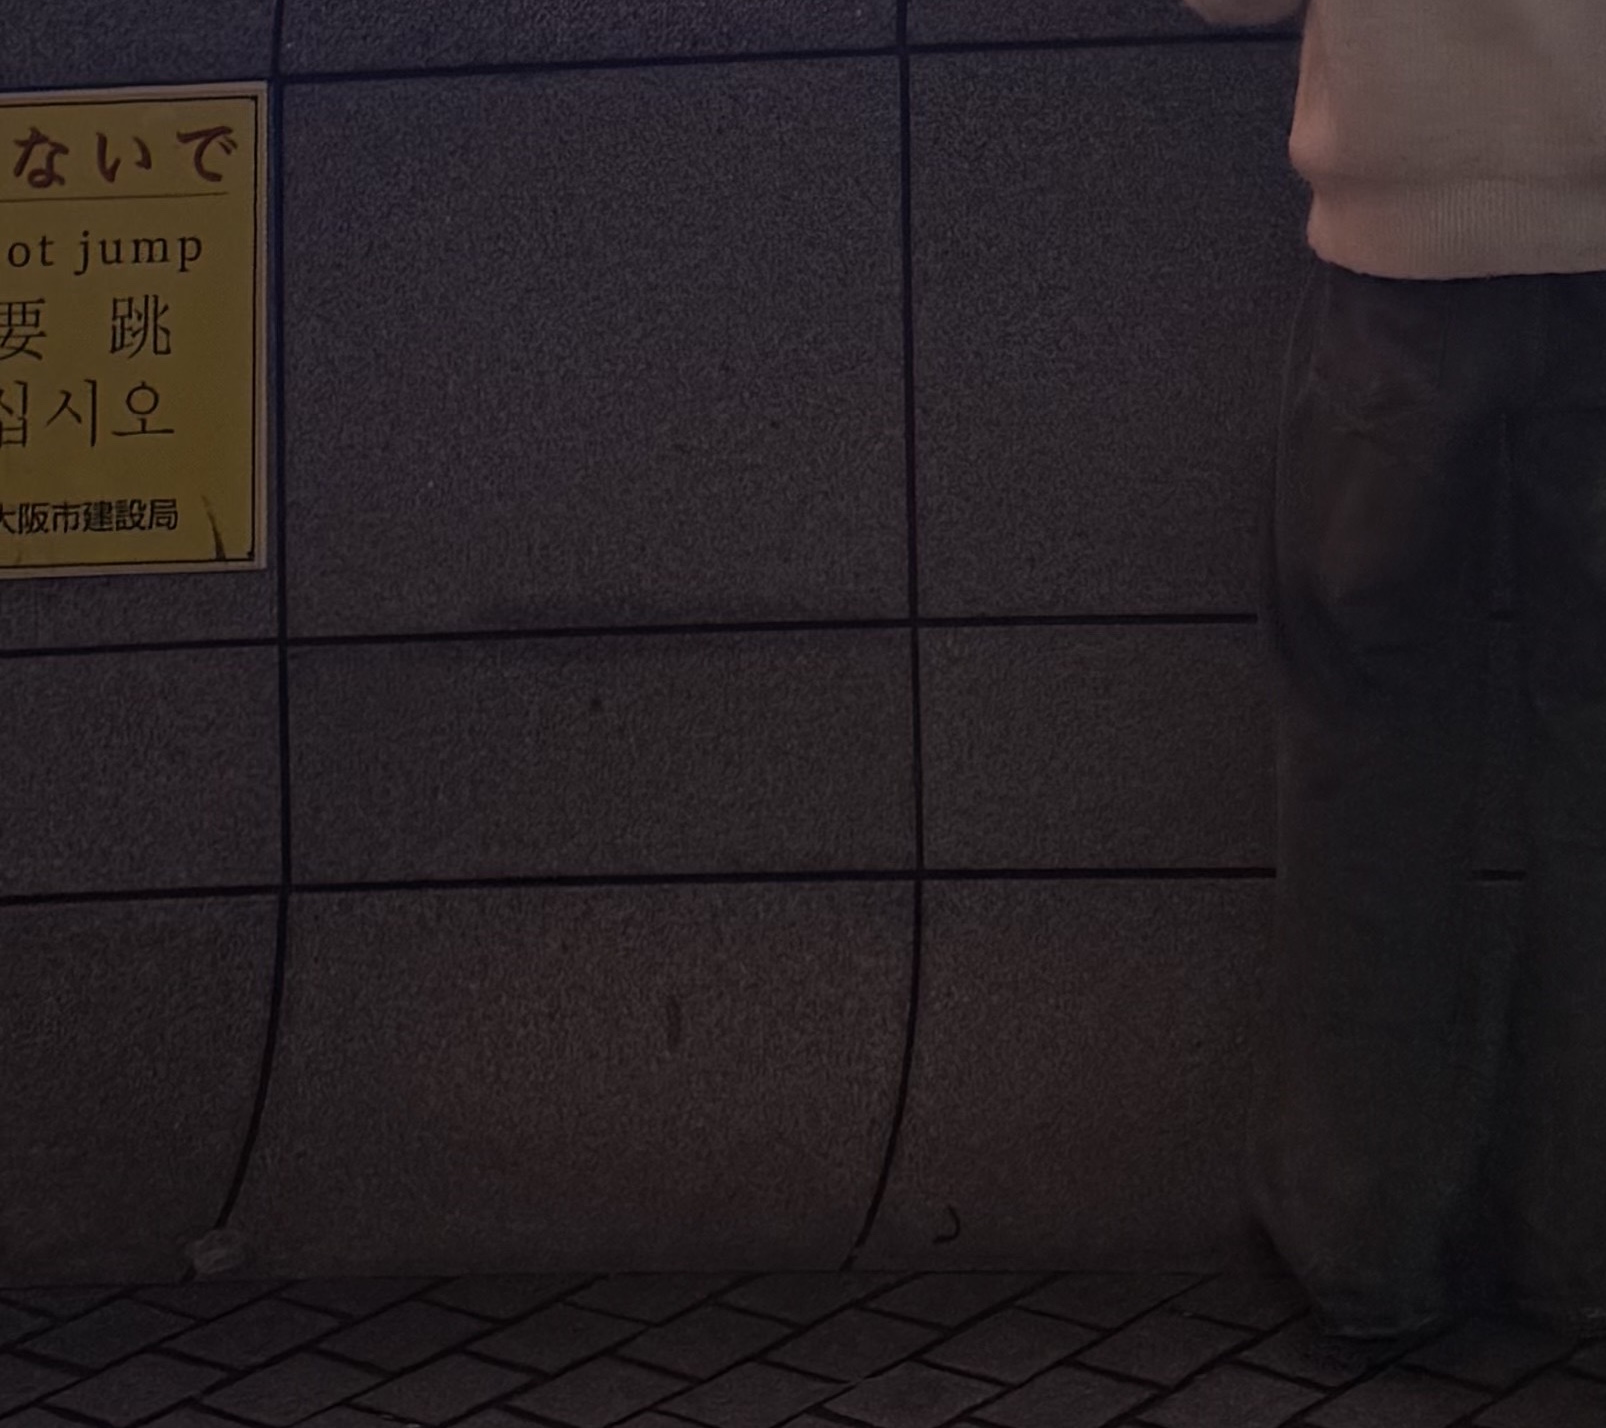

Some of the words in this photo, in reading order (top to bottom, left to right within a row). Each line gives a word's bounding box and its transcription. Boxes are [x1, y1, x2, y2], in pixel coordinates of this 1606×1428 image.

[13, 125, 238, 189] ないで
[8, 235, 54, 269] ot
[74, 230, 203, 276] jump
